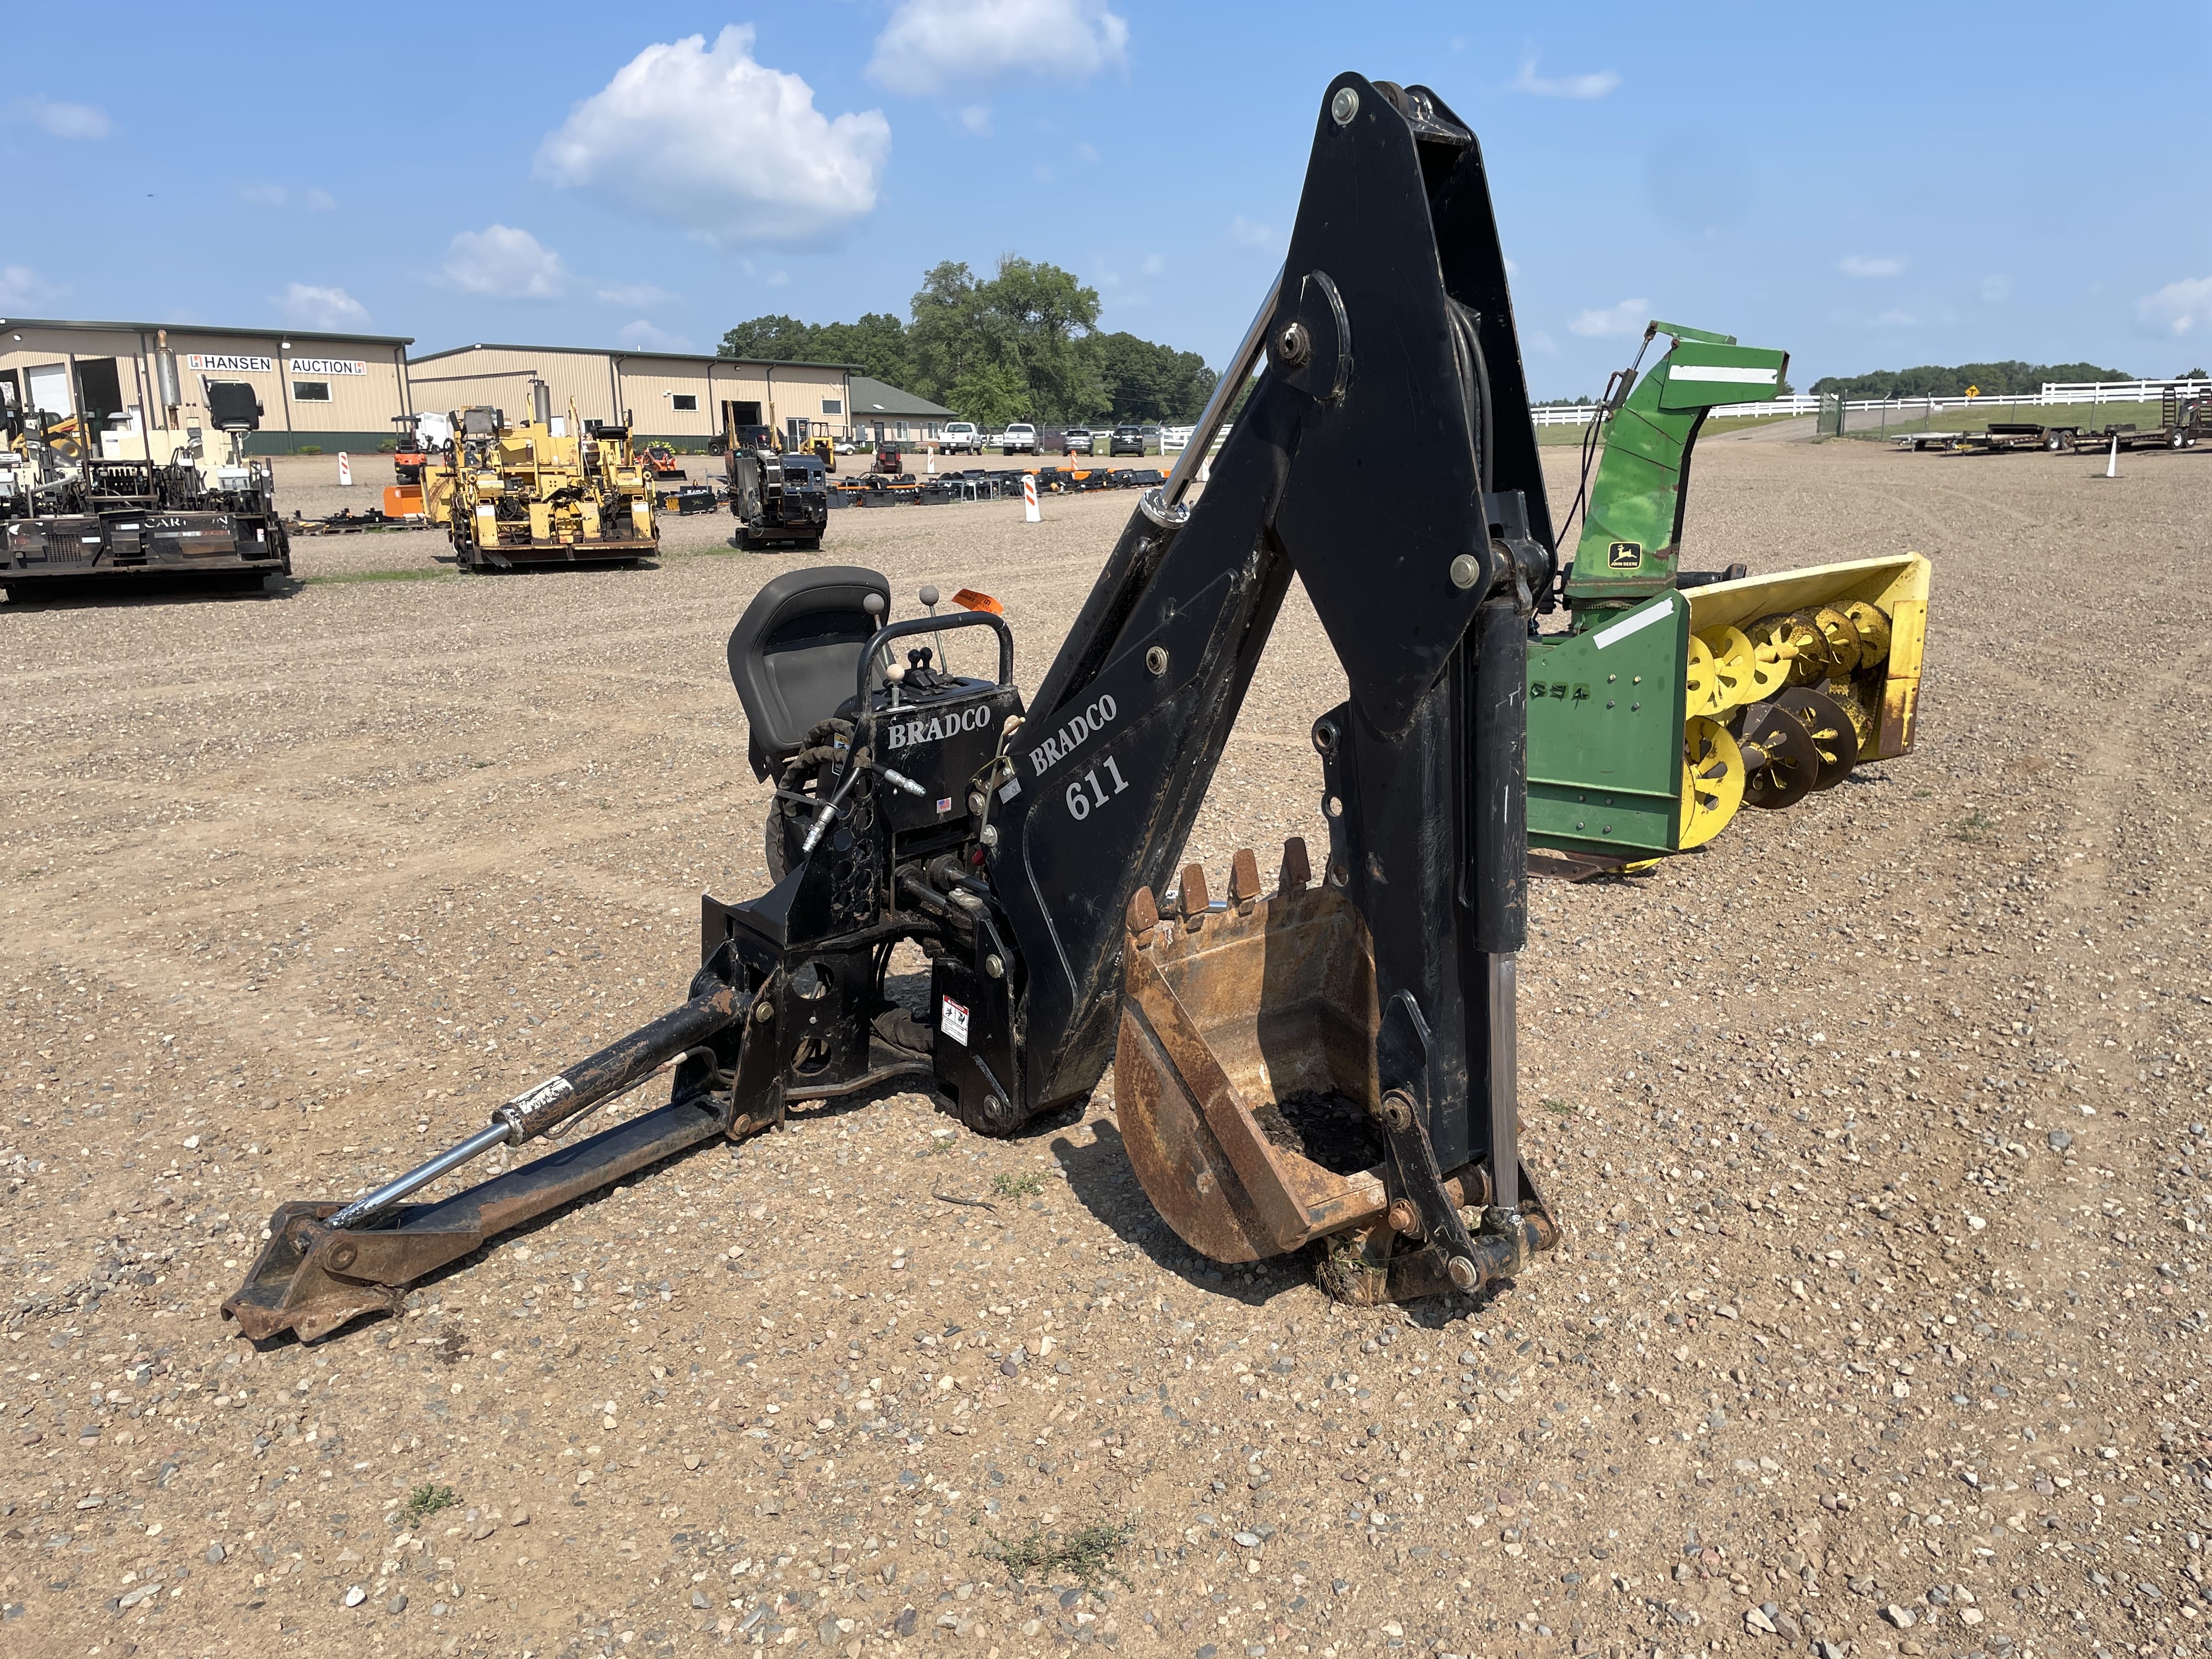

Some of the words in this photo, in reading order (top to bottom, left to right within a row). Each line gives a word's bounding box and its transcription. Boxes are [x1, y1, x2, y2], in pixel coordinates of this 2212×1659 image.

[205, 356, 270, 370] HANSEN
[292, 360, 352, 373] AUCTION
[888, 705, 991, 750] BRADCO
[1028, 694, 1117, 777] BRADCO
[1065, 754, 1130, 821] 611
